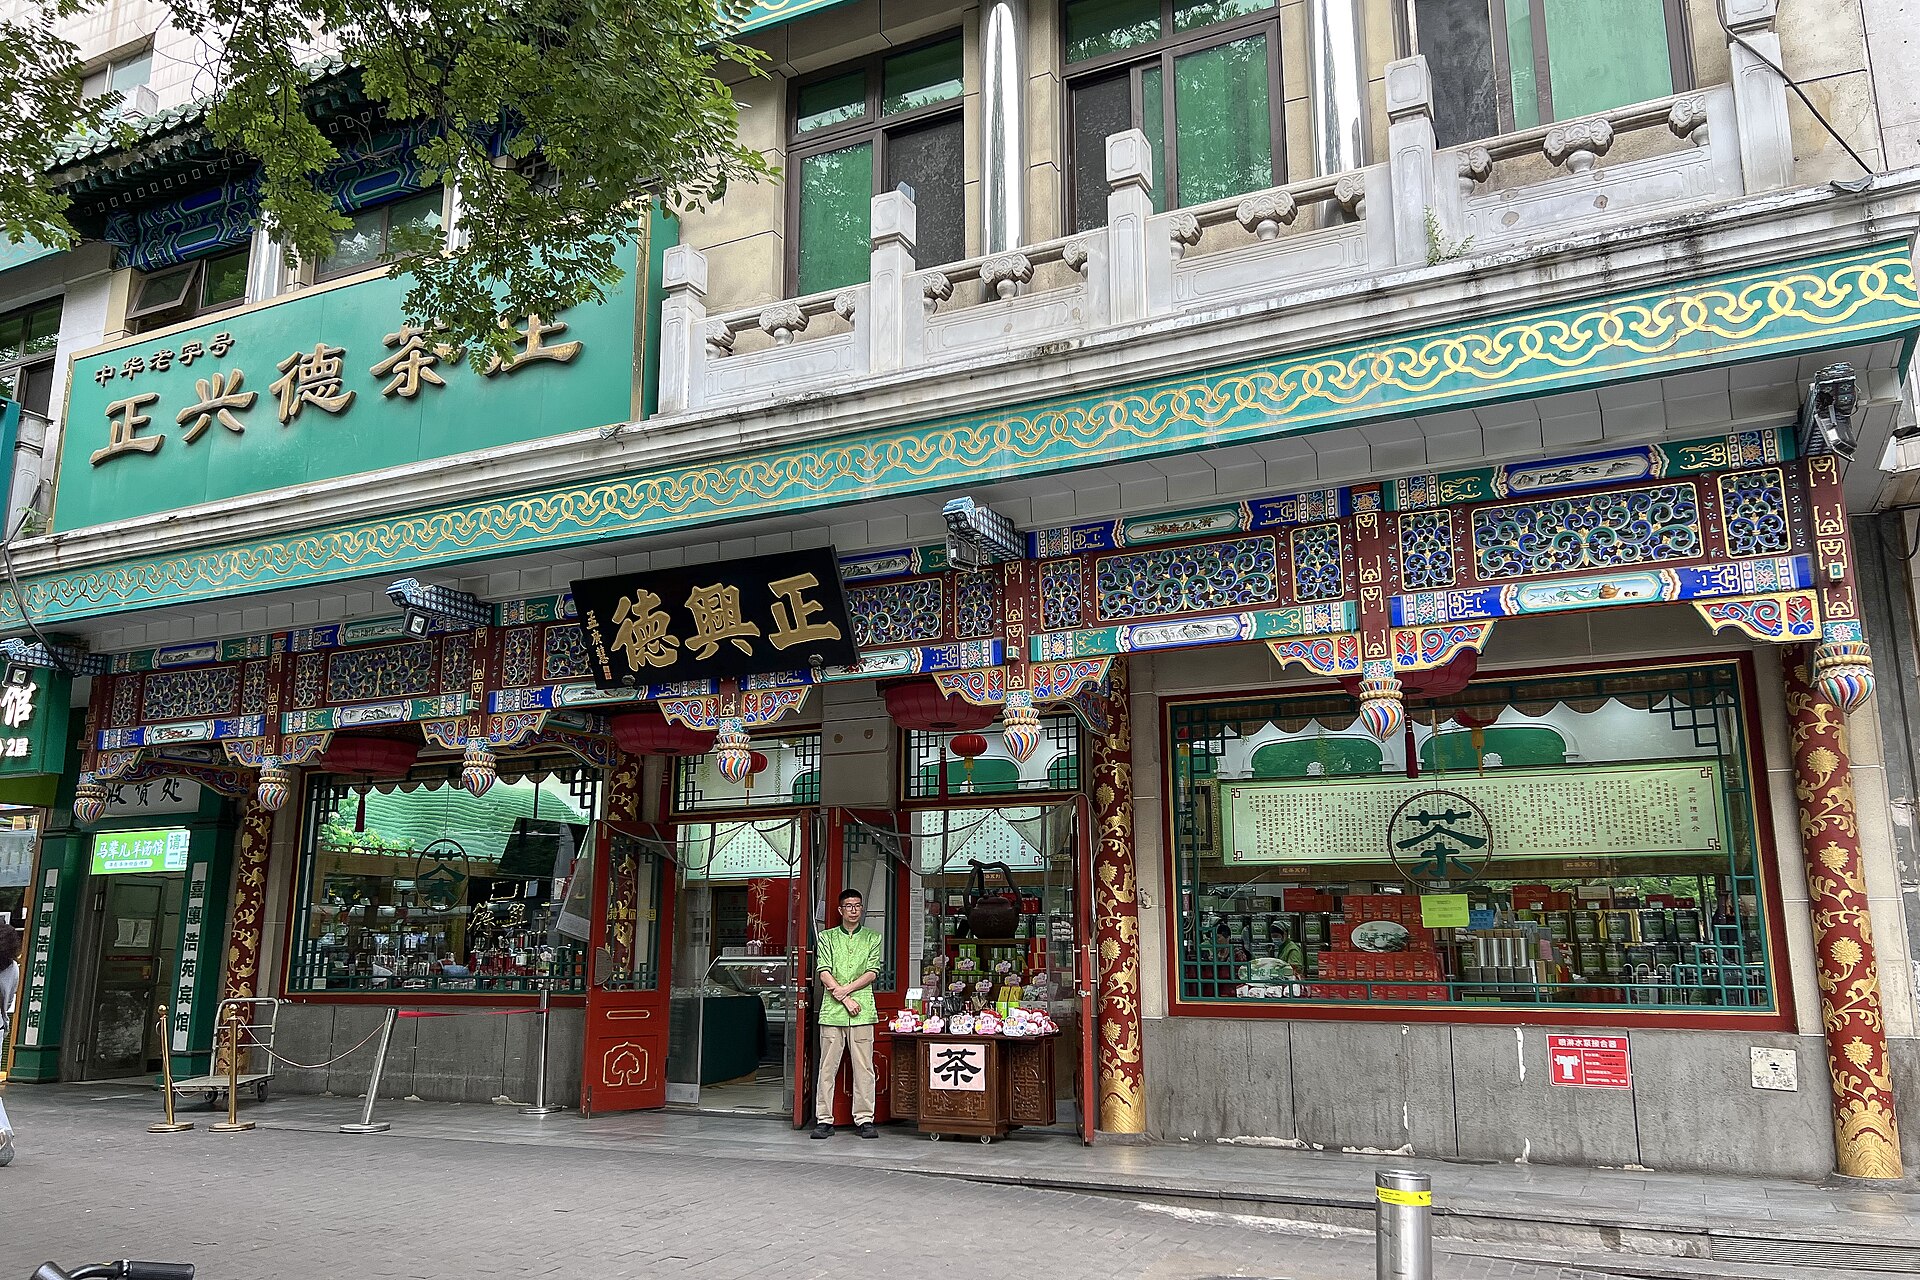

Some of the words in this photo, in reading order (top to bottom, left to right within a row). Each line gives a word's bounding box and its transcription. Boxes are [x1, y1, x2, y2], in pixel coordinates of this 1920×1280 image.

[94, 332, 236, 388] 中华老字号
[89, 312, 583, 467] 正兴德茶庄
[611, 572, 841, 672] 正興德
[0, 682, 37, 728] 馆
[1396, 808, 1488, 879] 茶
[418, 848, 467, 902] 茶
[934, 1048, 981, 1086] 茶
